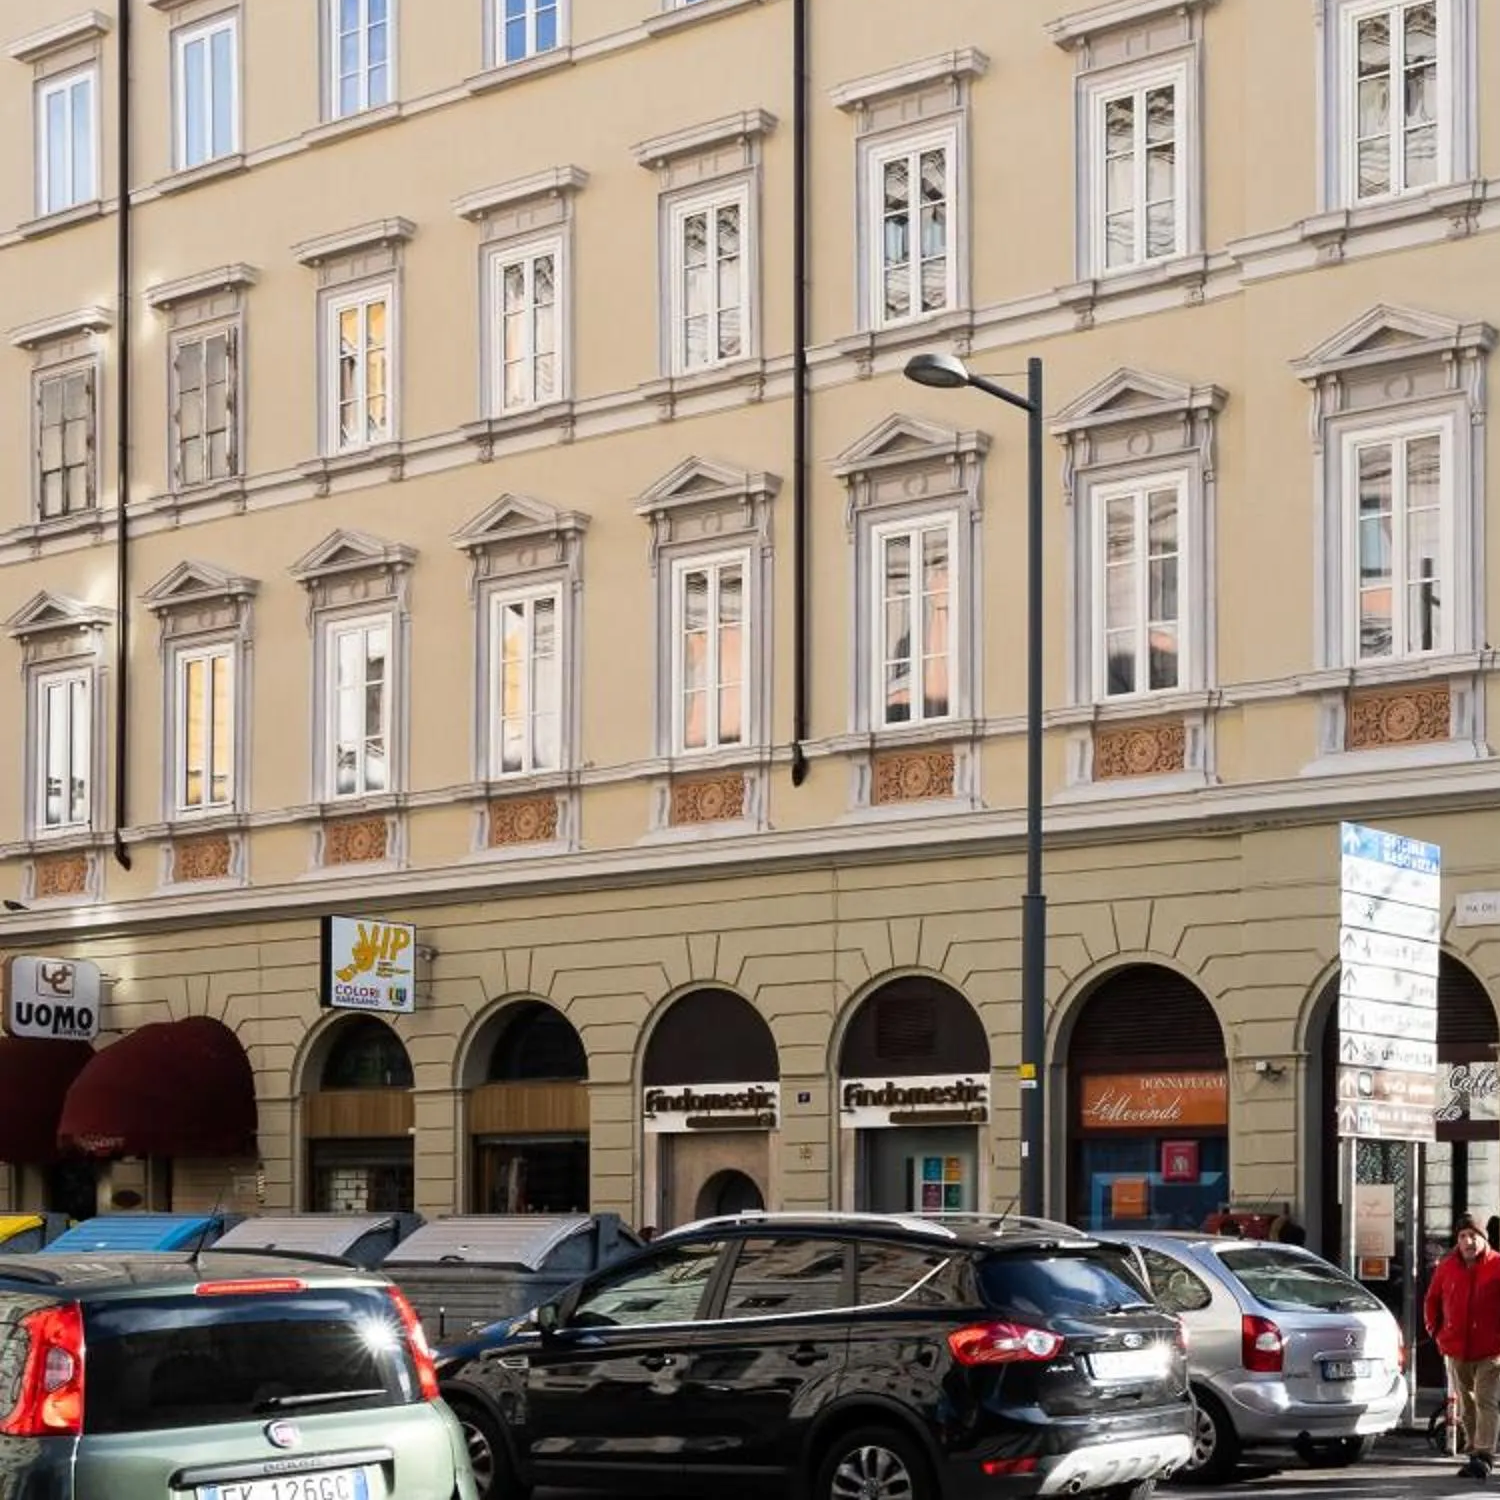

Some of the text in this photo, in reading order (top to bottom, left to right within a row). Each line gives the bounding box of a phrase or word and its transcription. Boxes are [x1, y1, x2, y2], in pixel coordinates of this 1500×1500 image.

[15, 1001, 93, 1035] UOMO
[646, 1085, 776, 1112] Findomestic
[843, 1077, 987, 1107] Findomestic
